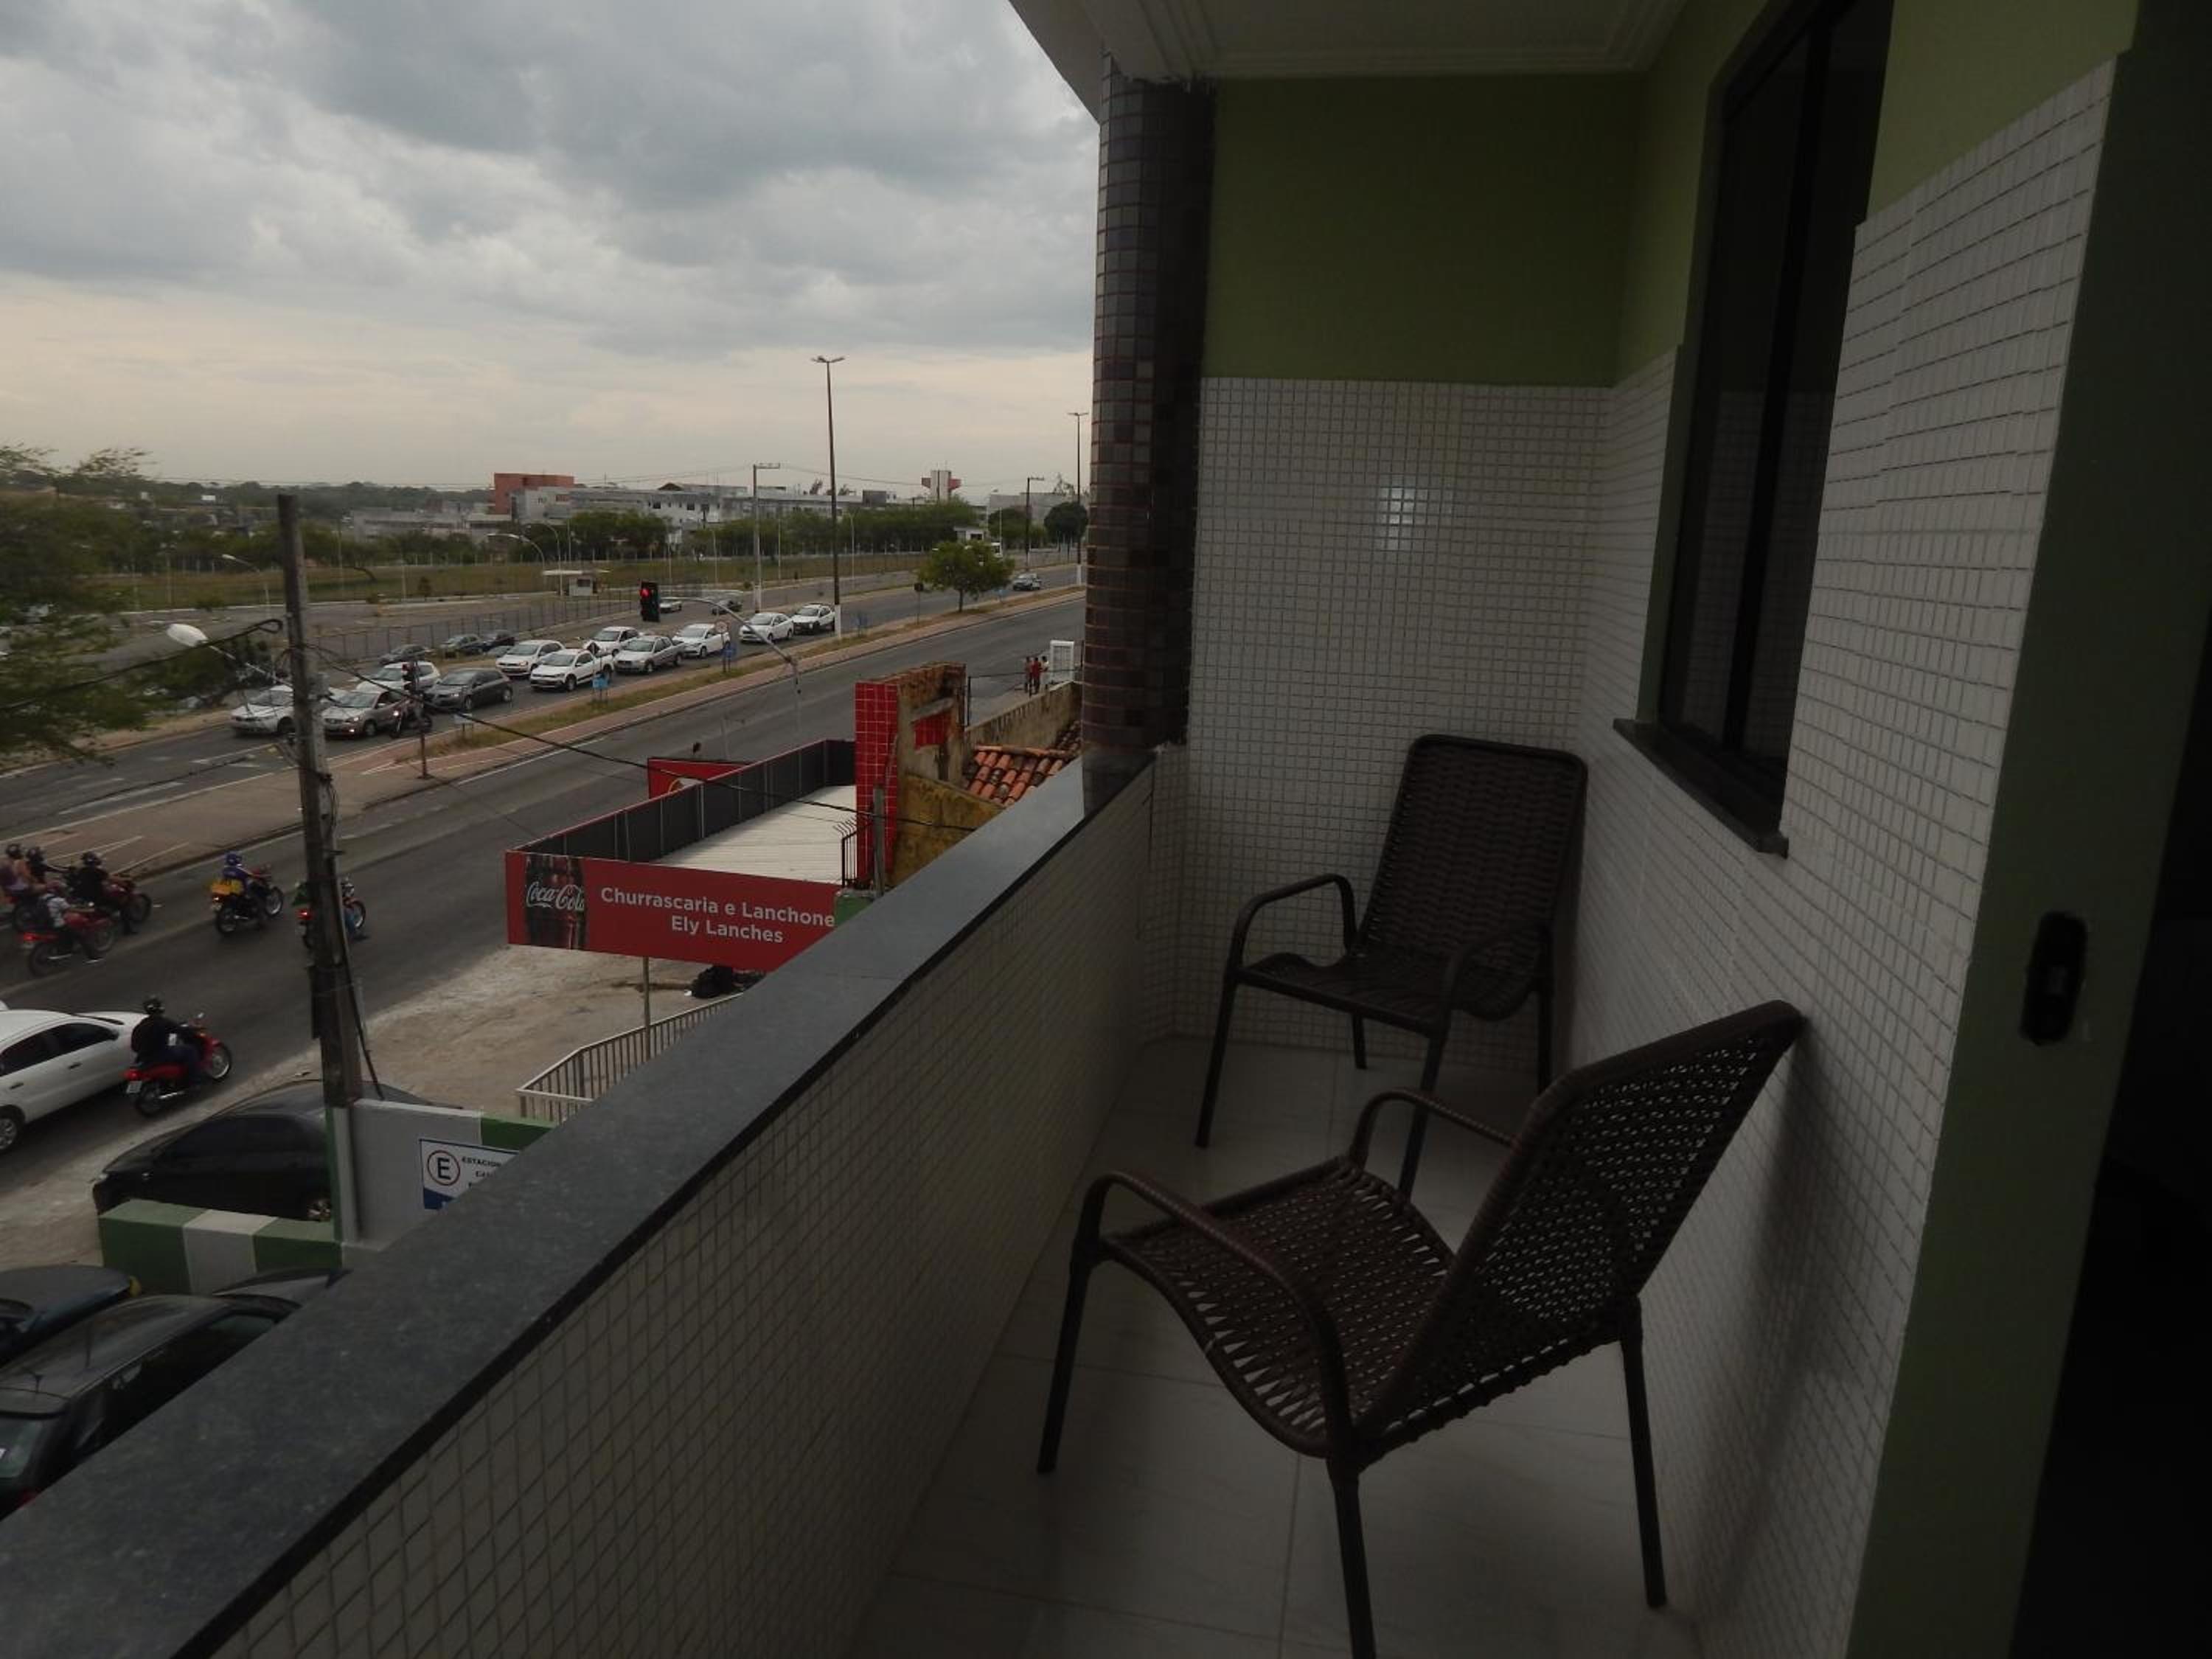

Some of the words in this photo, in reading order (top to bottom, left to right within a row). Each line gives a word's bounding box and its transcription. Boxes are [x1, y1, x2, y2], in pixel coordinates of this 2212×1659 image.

[526, 881, 584, 911] Coca-Cola
[601, 887, 718, 914] Churrascaria
[725, 902, 735, 915] e
[742, 902, 835, 927] Lanchone
[671, 915, 699, 935] Ely
[706, 919, 784, 943] Lanches
[437, 1158, 451, 1180] E
